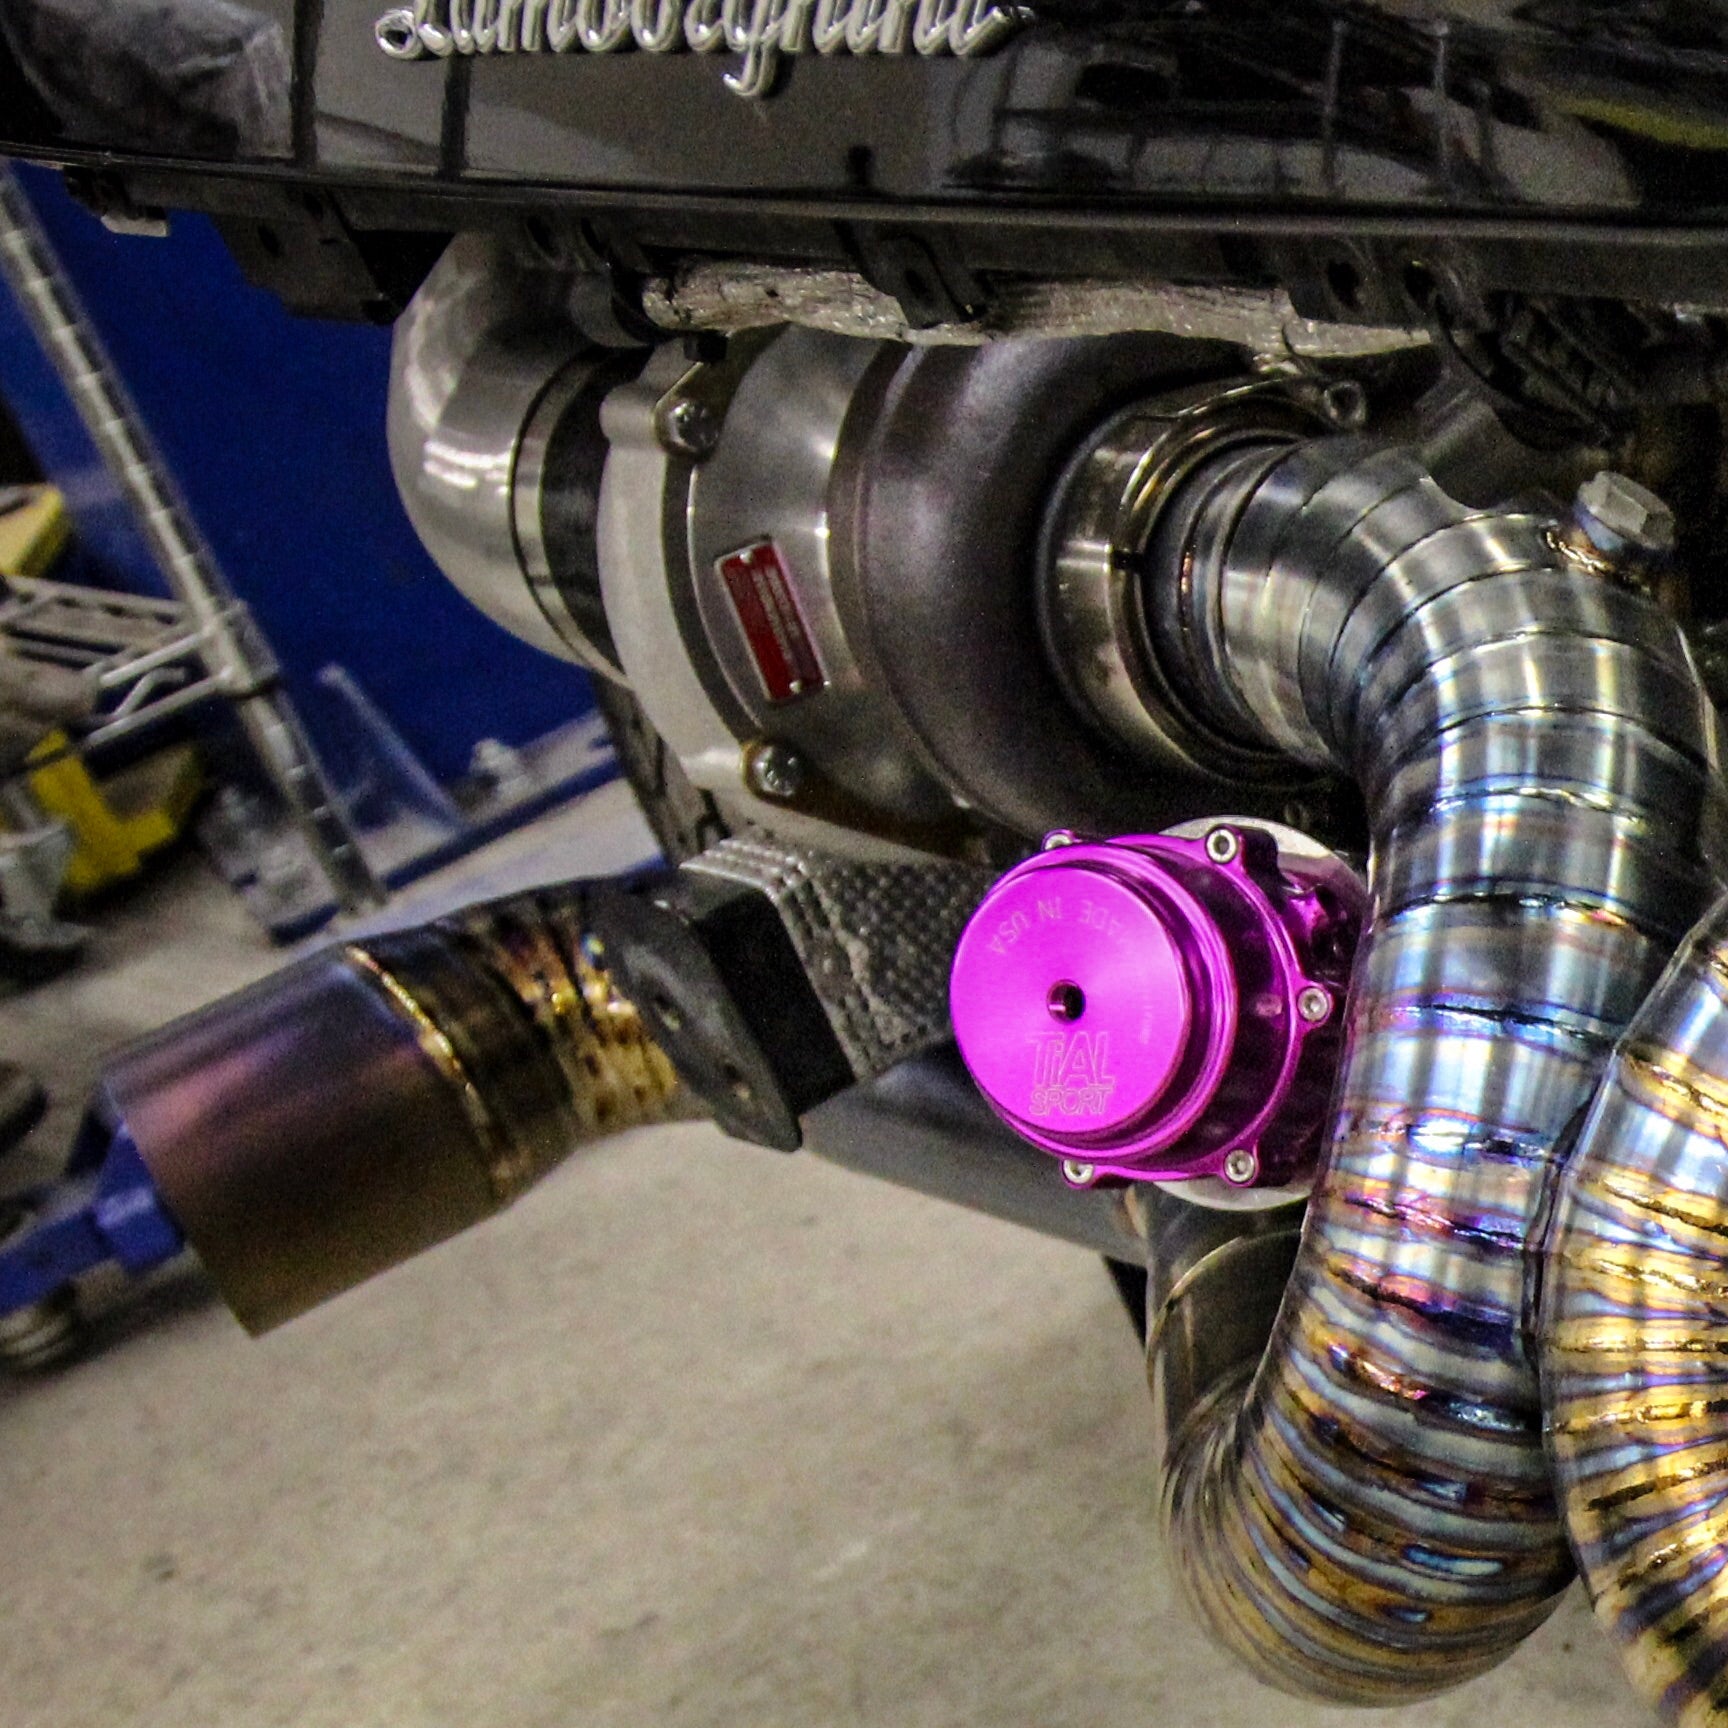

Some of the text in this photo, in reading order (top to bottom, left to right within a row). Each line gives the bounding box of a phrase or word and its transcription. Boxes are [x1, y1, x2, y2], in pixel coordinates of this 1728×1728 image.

[1036, 896, 1063, 921] IN
[985, 910, 1031, 954] USA
[1028, 1086, 1114, 1117] SPORT
